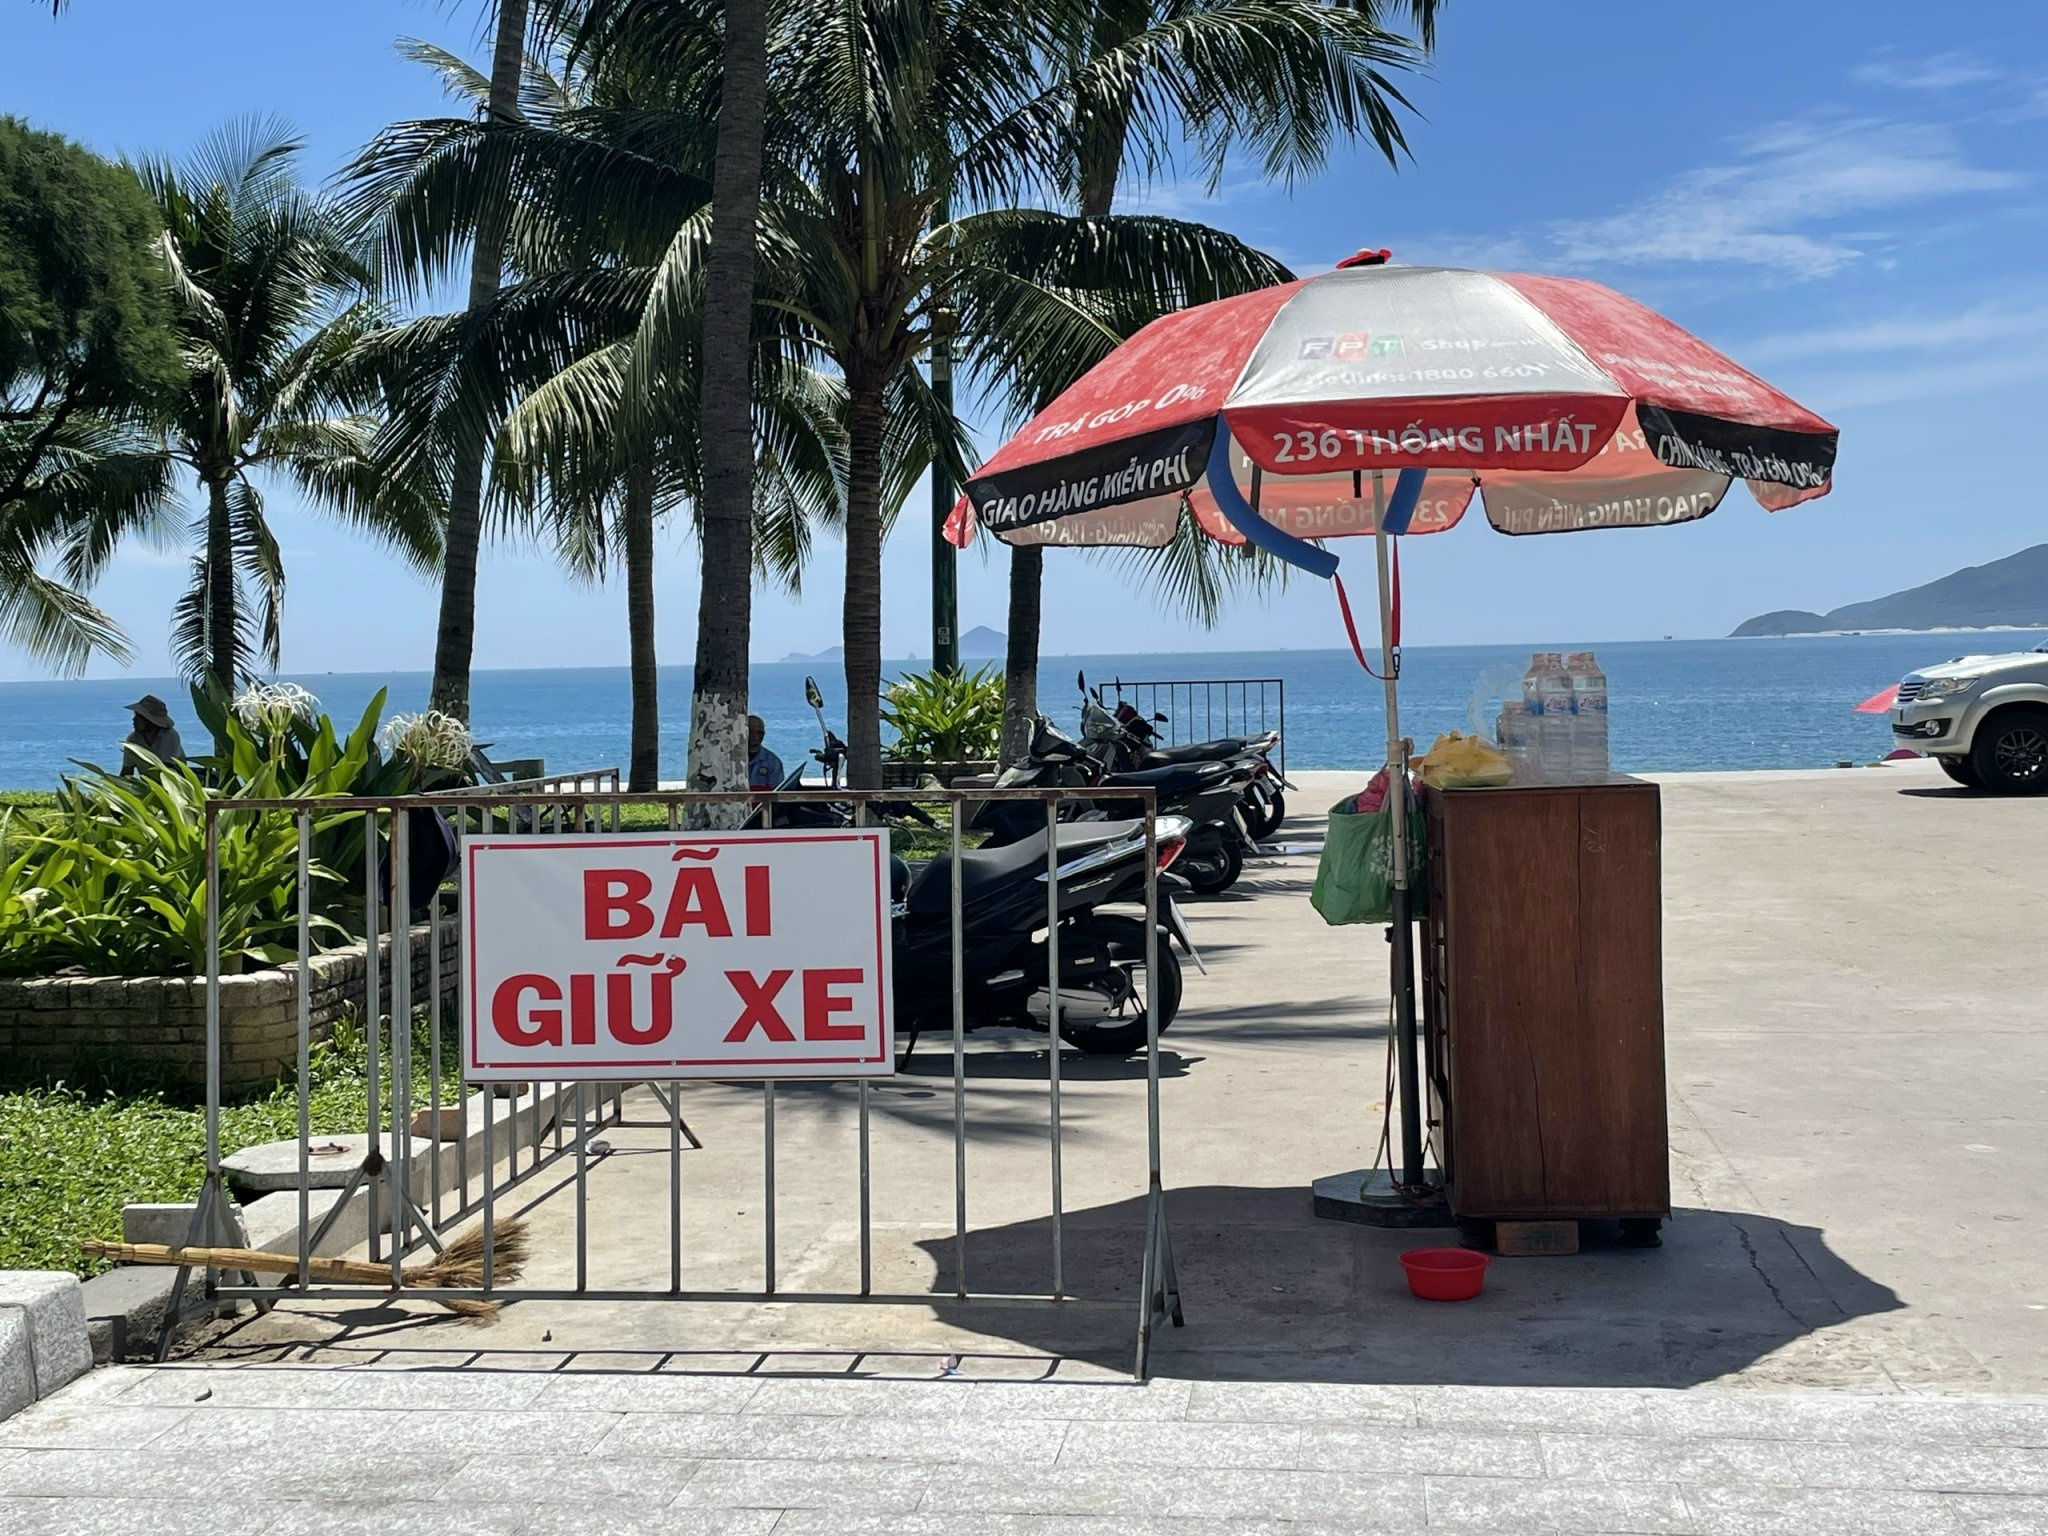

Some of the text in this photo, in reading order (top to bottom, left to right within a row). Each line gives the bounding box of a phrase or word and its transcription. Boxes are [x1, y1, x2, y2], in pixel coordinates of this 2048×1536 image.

[1301, 334, 1402, 358] FPT
[1411, 368, 1474, 382] 1800
[1033, 383, 1207, 444] TRẢ GÓP 0%
[1273, 413, 1598, 464] 236 THỐNG NHẤT
[982, 445, 1191, 527] GIAO HÀNG MIỄN PHÍ
[1731, 446, 1767, 480] TRẢ
[1791, 461, 1824, 487] 0%
[583, 847, 772, 940] BÃI
[491, 952, 866, 1047] GIỮ XE
